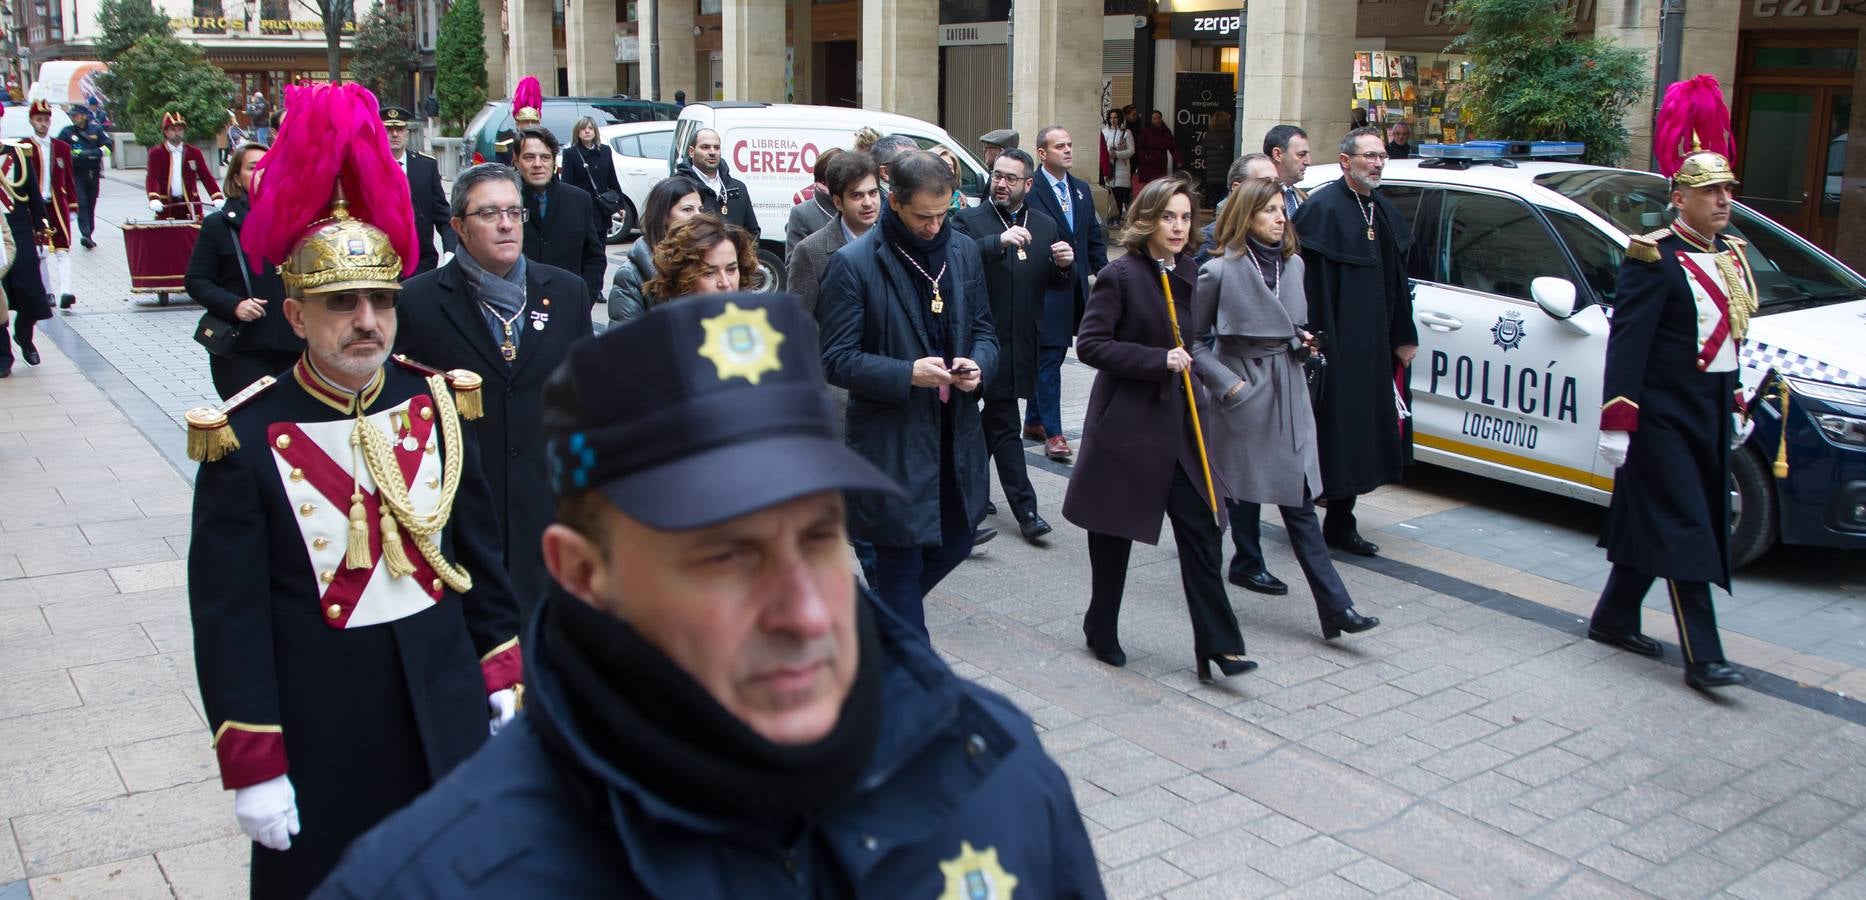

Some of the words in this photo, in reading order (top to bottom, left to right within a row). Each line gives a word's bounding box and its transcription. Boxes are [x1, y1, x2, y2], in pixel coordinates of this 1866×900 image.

[946, 28, 979, 40] CATEDRAL
[751, 137, 798, 149] LIBRERÍA
[1430, 350, 1578, 424] POLICÍA
[1462, 411, 1539, 450] LOGROÑO
